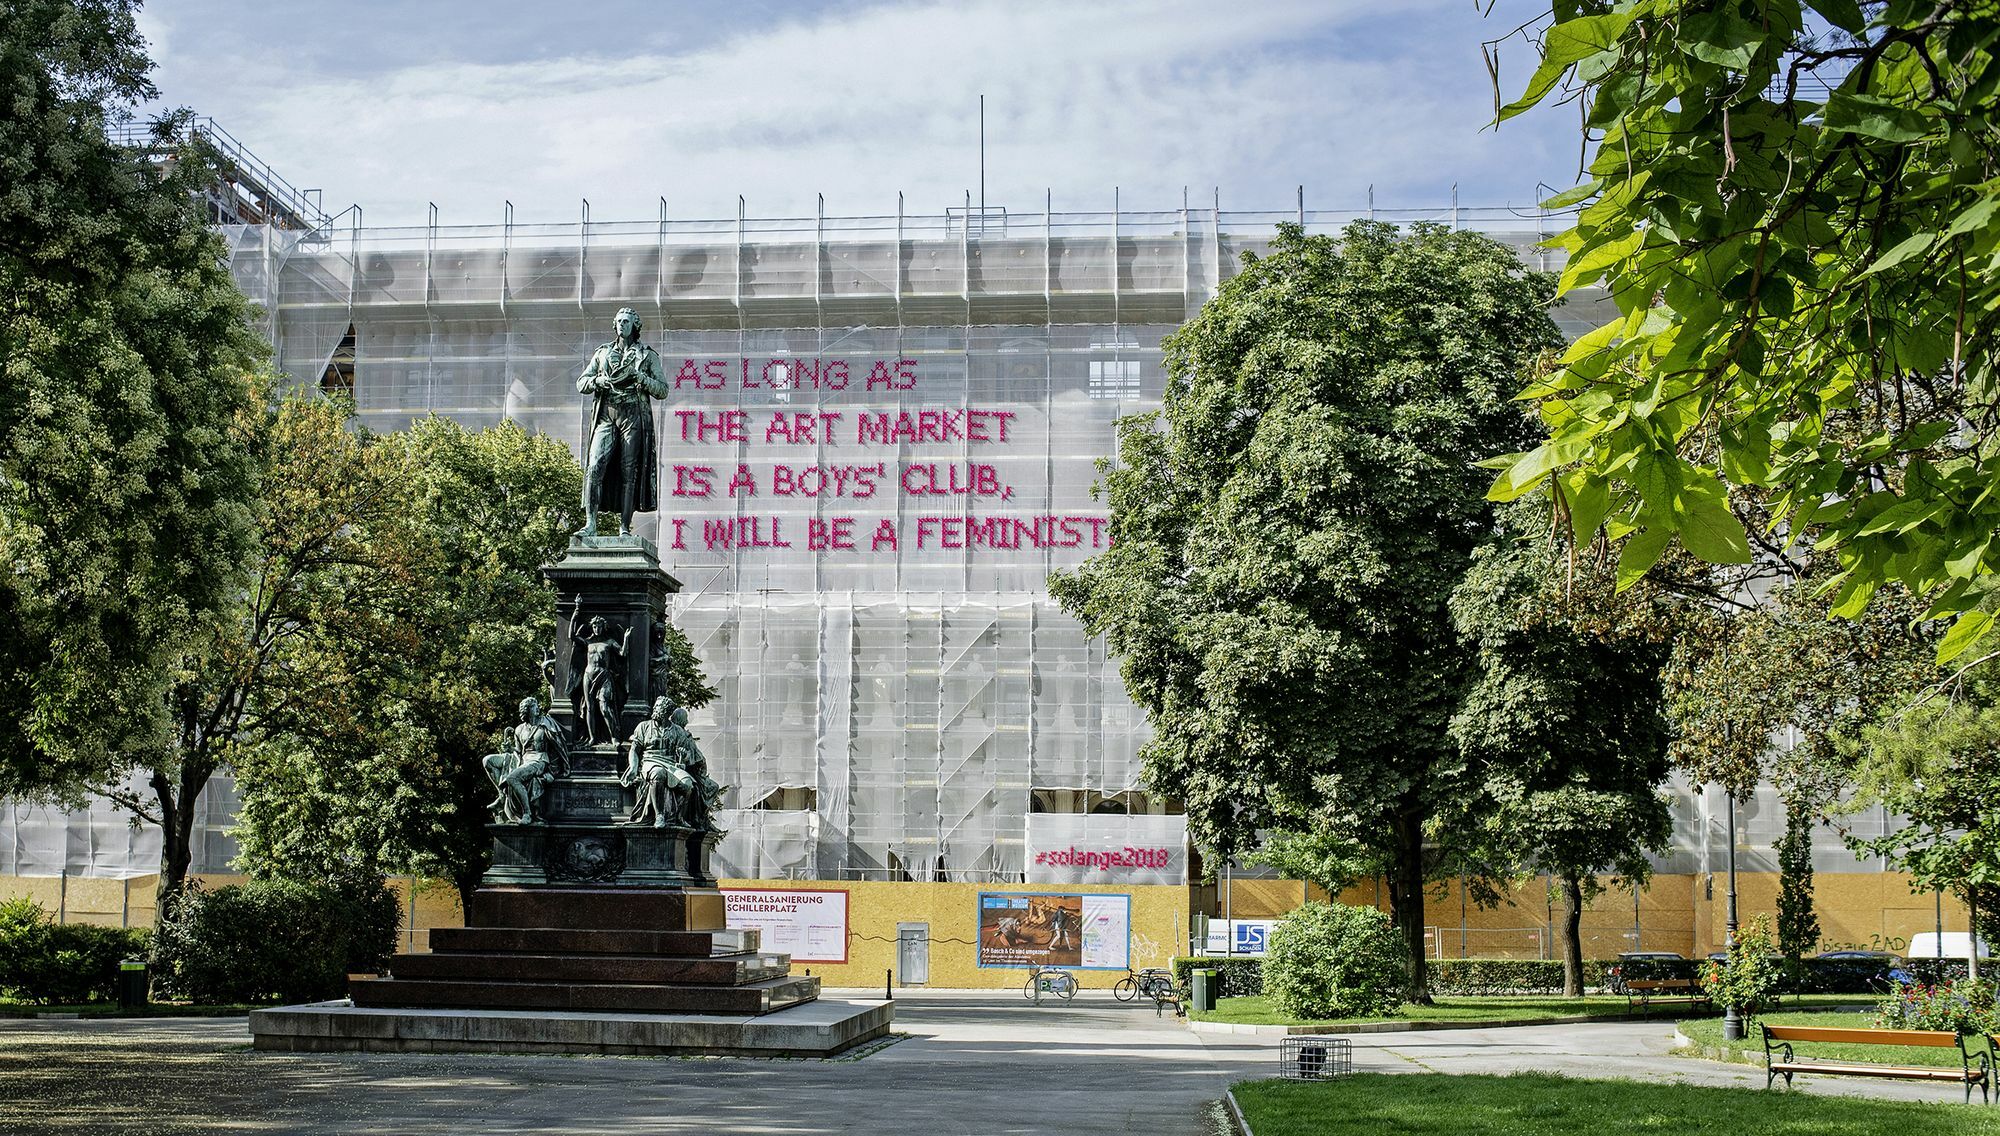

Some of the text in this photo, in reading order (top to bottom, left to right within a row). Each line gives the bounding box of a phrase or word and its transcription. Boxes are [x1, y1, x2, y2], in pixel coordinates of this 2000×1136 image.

[675, 359, 917, 390] AS LONG AS
[675, 409, 1014, 444] THE ART MARKET
[673, 463, 1014, 500] IS A BOYS' CLUB,
[672, 519, 686, 549] I
[704, 517, 791, 550] WILL
[808, 518, 855, 550] BE
[872, 519, 898, 551] A
[1036, 848, 1169, 870] #solange2018
[727, 895, 823, 904] GENERALSANIERUNG
[727, 903, 797, 913] SCHILLERPLATZ
[1237, 925, 1263, 944] JS
[1822, 938, 1843, 953] bis
[1870, 933, 1906, 952] ZAD
